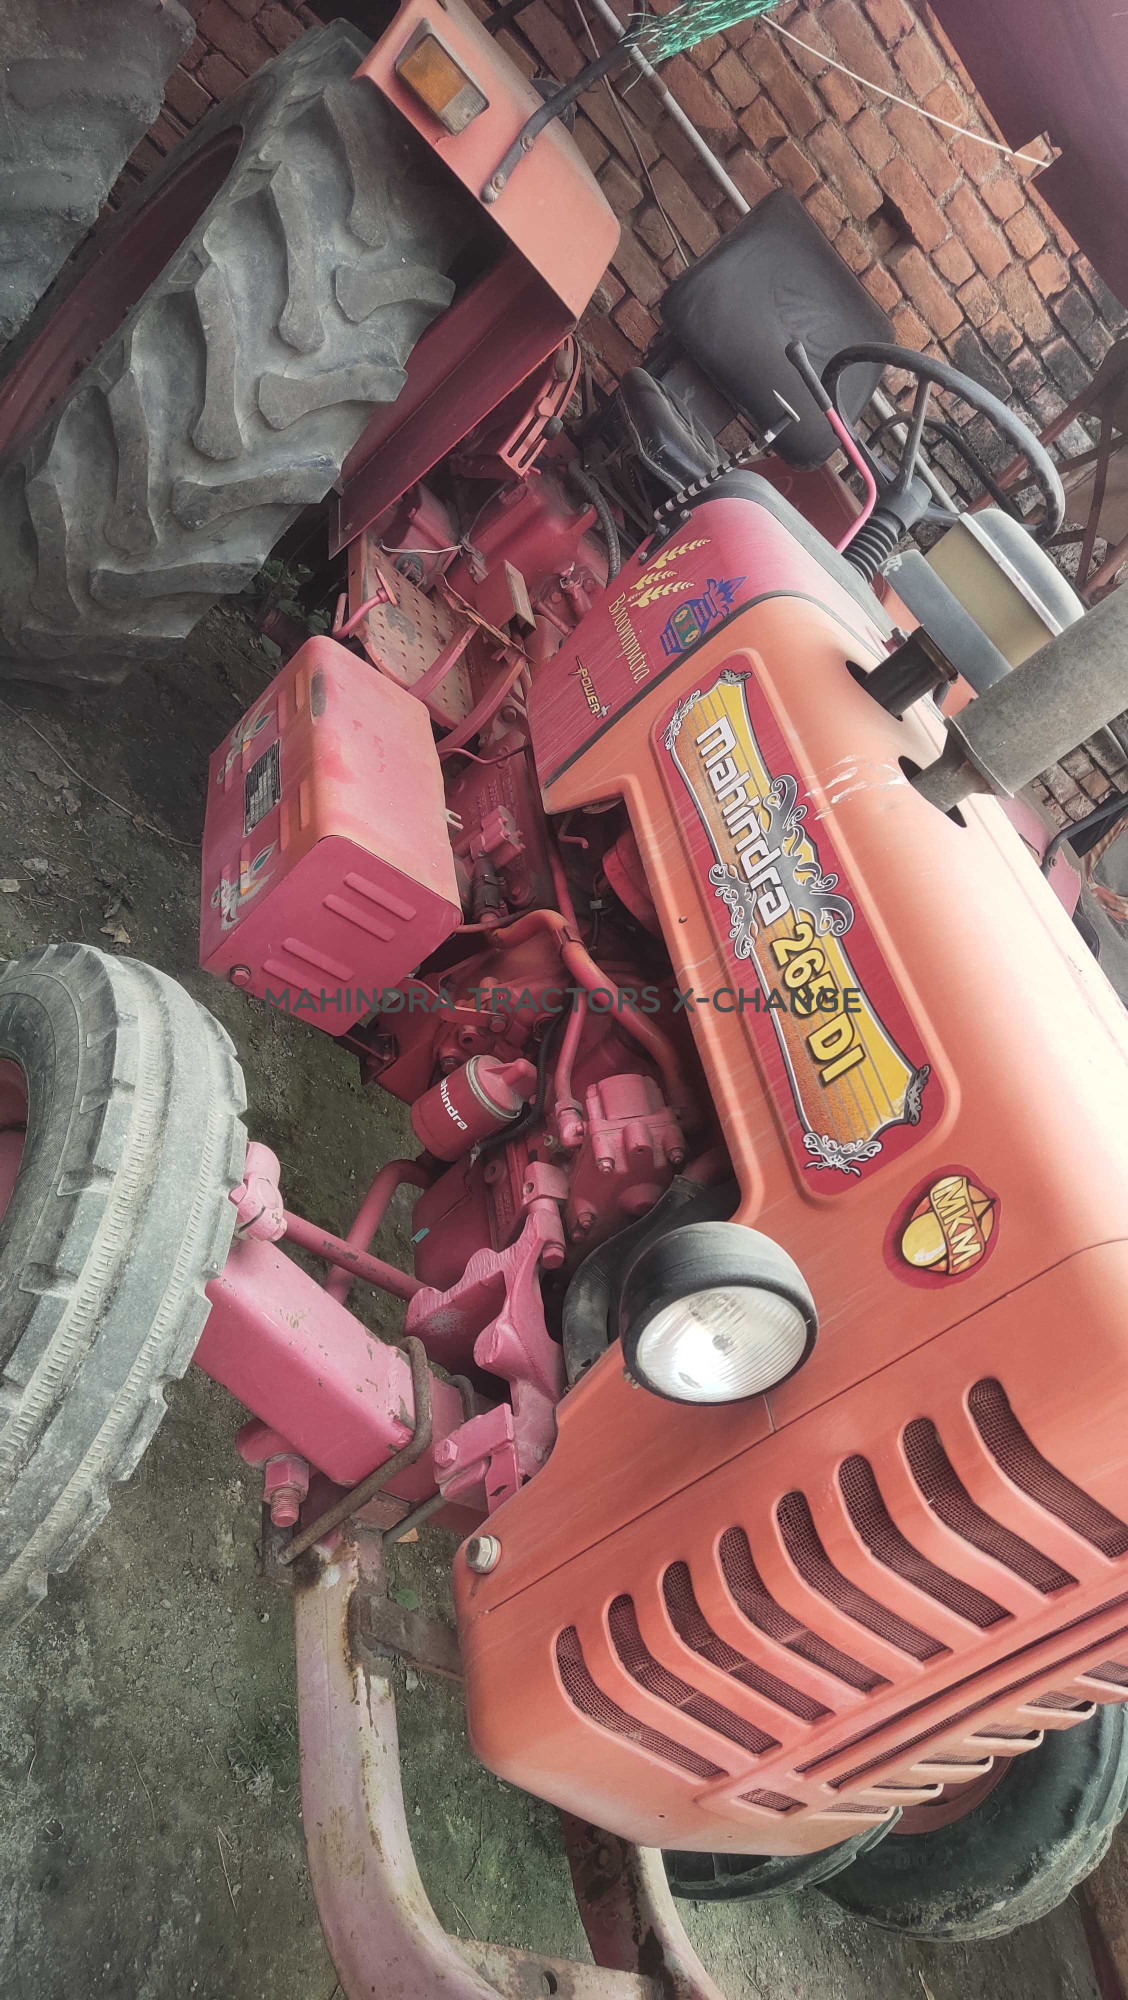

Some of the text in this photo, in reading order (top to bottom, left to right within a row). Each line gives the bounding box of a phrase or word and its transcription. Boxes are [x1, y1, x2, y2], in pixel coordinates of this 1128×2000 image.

[772, 922, 839, 1016] 265
[808, 1012, 866, 1083] DI
[440, 1076, 468, 1130] ahindra
[932, 1177, 982, 1267] MKM
